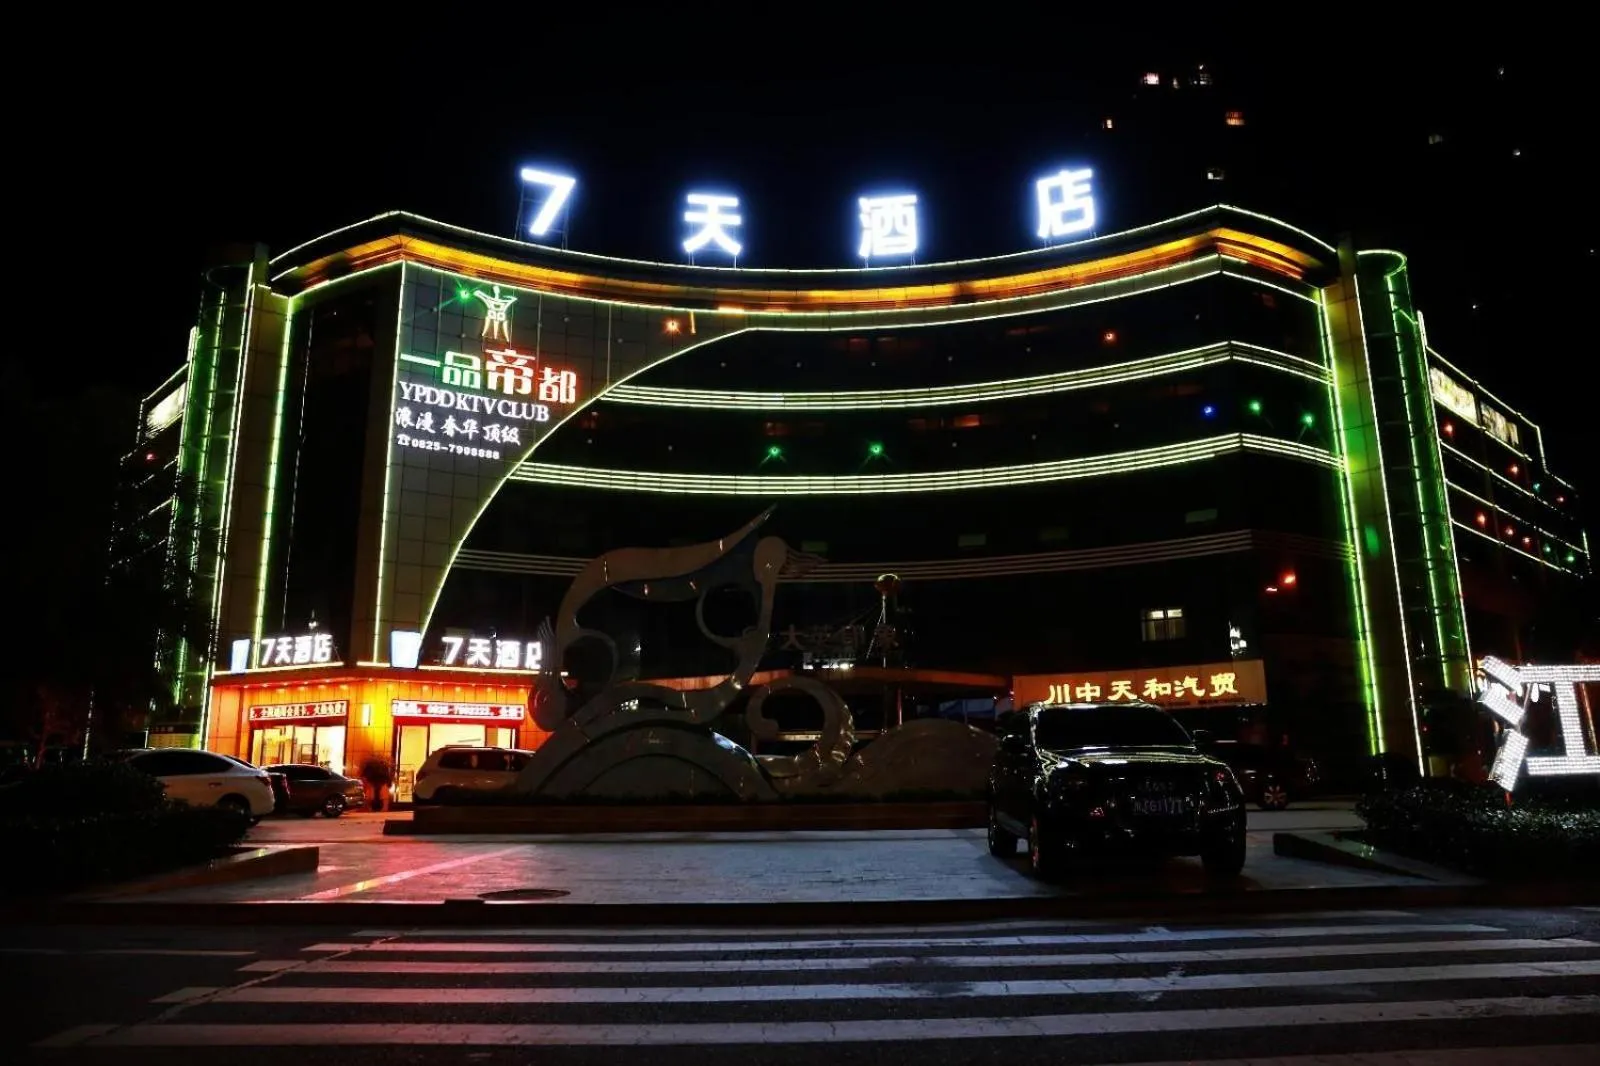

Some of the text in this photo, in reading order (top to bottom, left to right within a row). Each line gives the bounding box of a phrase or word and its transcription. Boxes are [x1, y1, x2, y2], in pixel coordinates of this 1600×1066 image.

[520, 167, 1096, 258] 7天酒店
[400, 348, 578, 404] 一品帝都
[260, 634, 333, 666] 7天酒店
[1048, 672, 1238, 704] 川中天和汽贸
